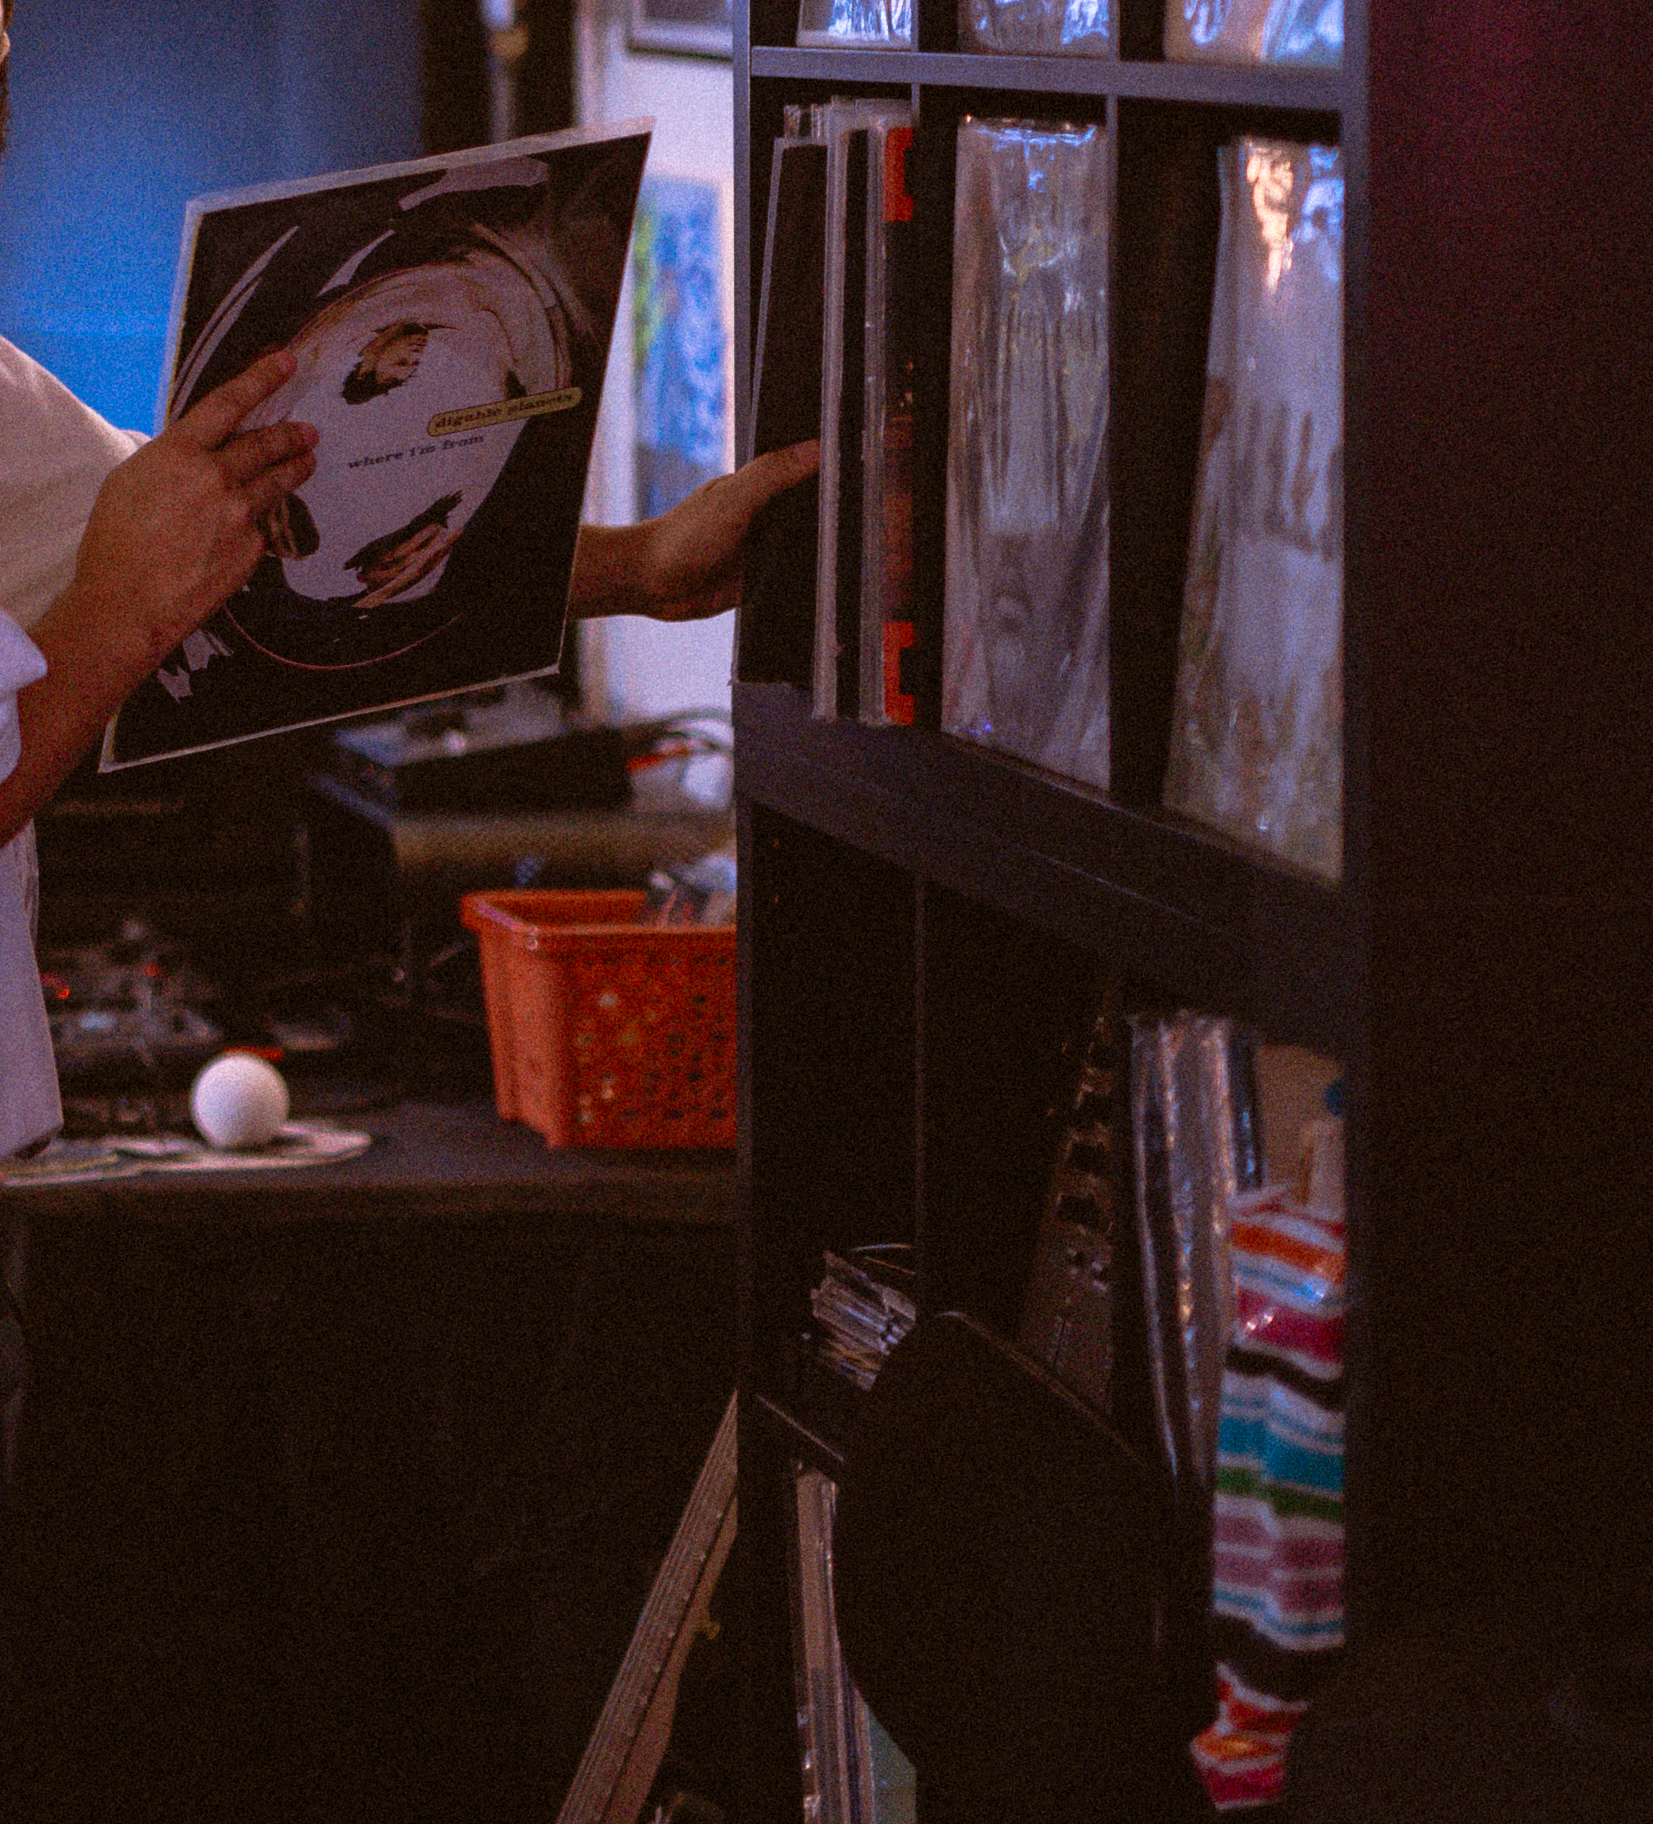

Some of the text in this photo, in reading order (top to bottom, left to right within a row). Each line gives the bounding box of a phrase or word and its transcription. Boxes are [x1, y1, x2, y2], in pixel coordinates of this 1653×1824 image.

[435, 405, 502, 429] digable
[348, 450, 404, 470] where
[442, 434, 485, 452] from
